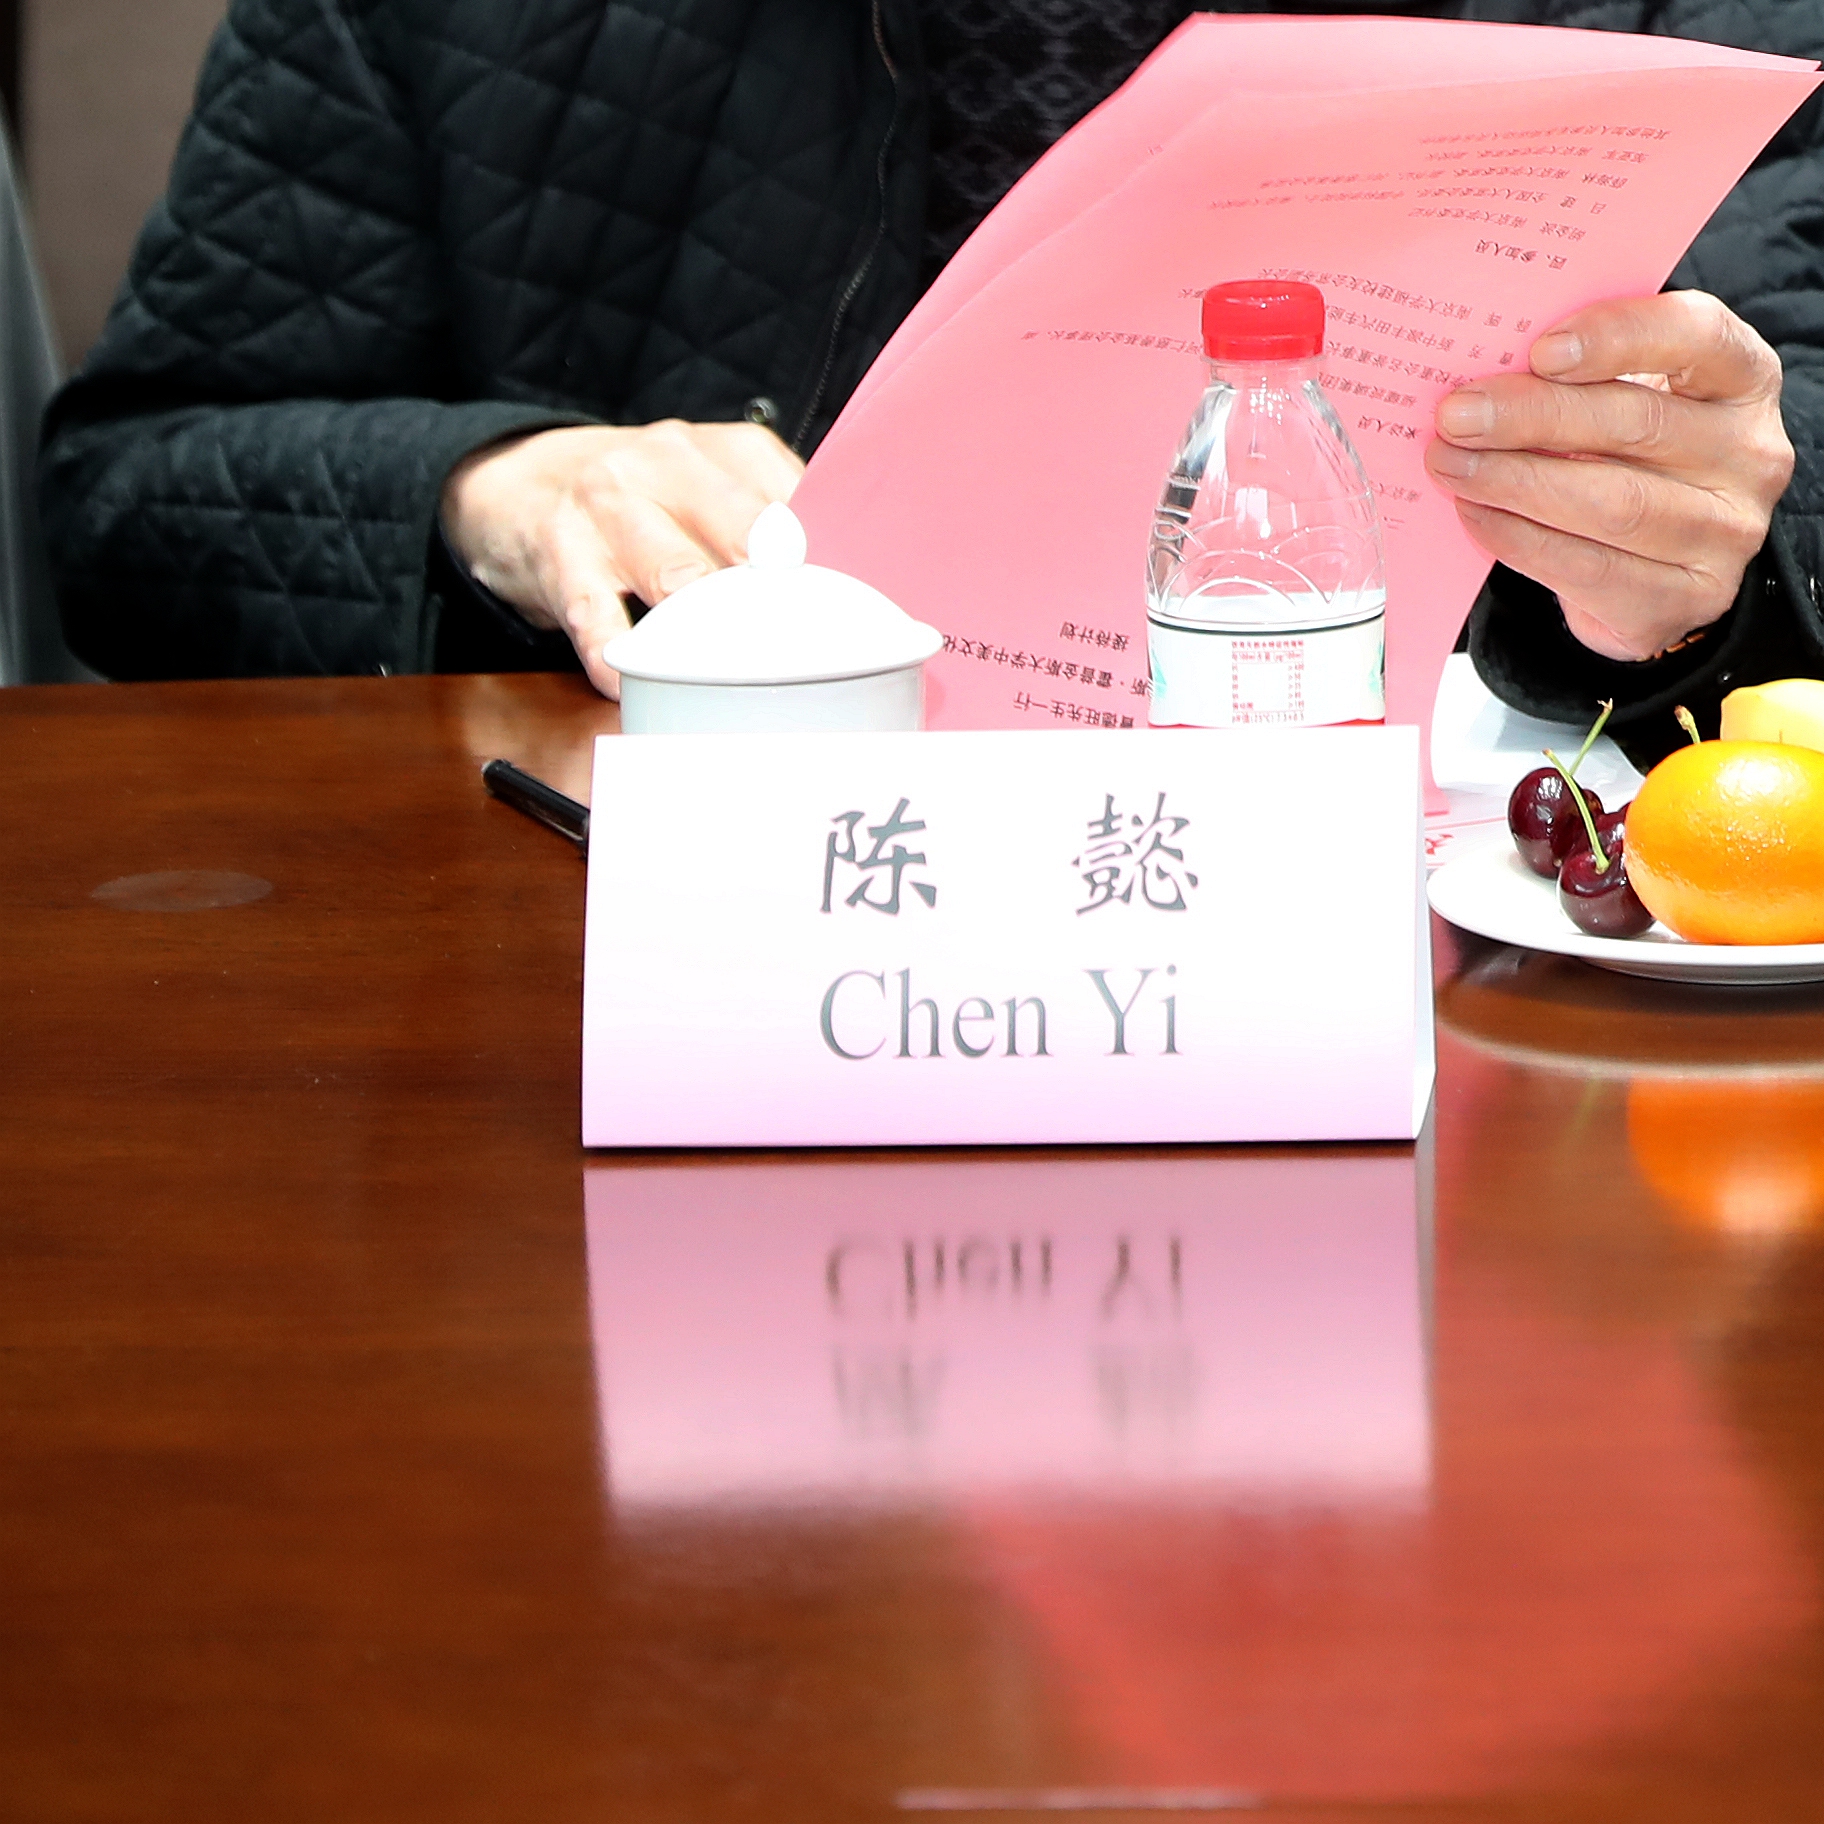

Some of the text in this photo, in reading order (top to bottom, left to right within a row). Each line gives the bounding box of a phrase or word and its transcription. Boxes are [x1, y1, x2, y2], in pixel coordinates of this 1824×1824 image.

[1325, 304, 1455, 352] 新中源丰田汽车能
[1060, 621, 1130, 652] 接待计划
[820, 791, 1199, 916] 陈 懿
[820, 965, 1182, 1062] Chen Yi
